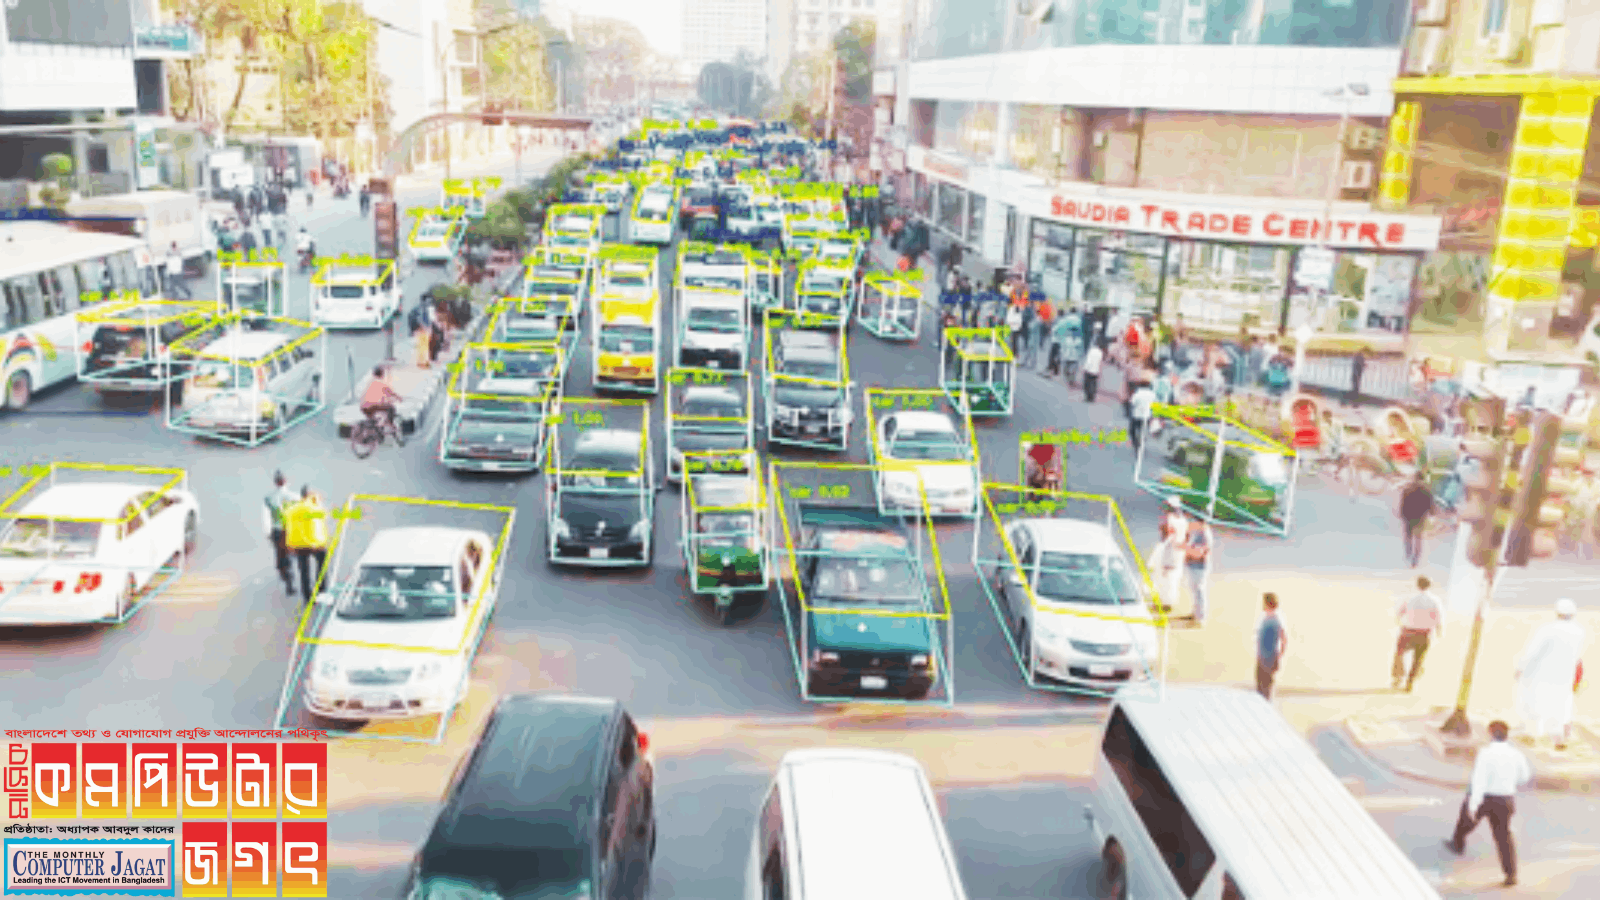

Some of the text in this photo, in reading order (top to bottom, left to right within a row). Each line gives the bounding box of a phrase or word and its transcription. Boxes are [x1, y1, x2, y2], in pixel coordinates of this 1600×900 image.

[1051, 195, 1405, 247] SAUDIA TRADE CENTRE
